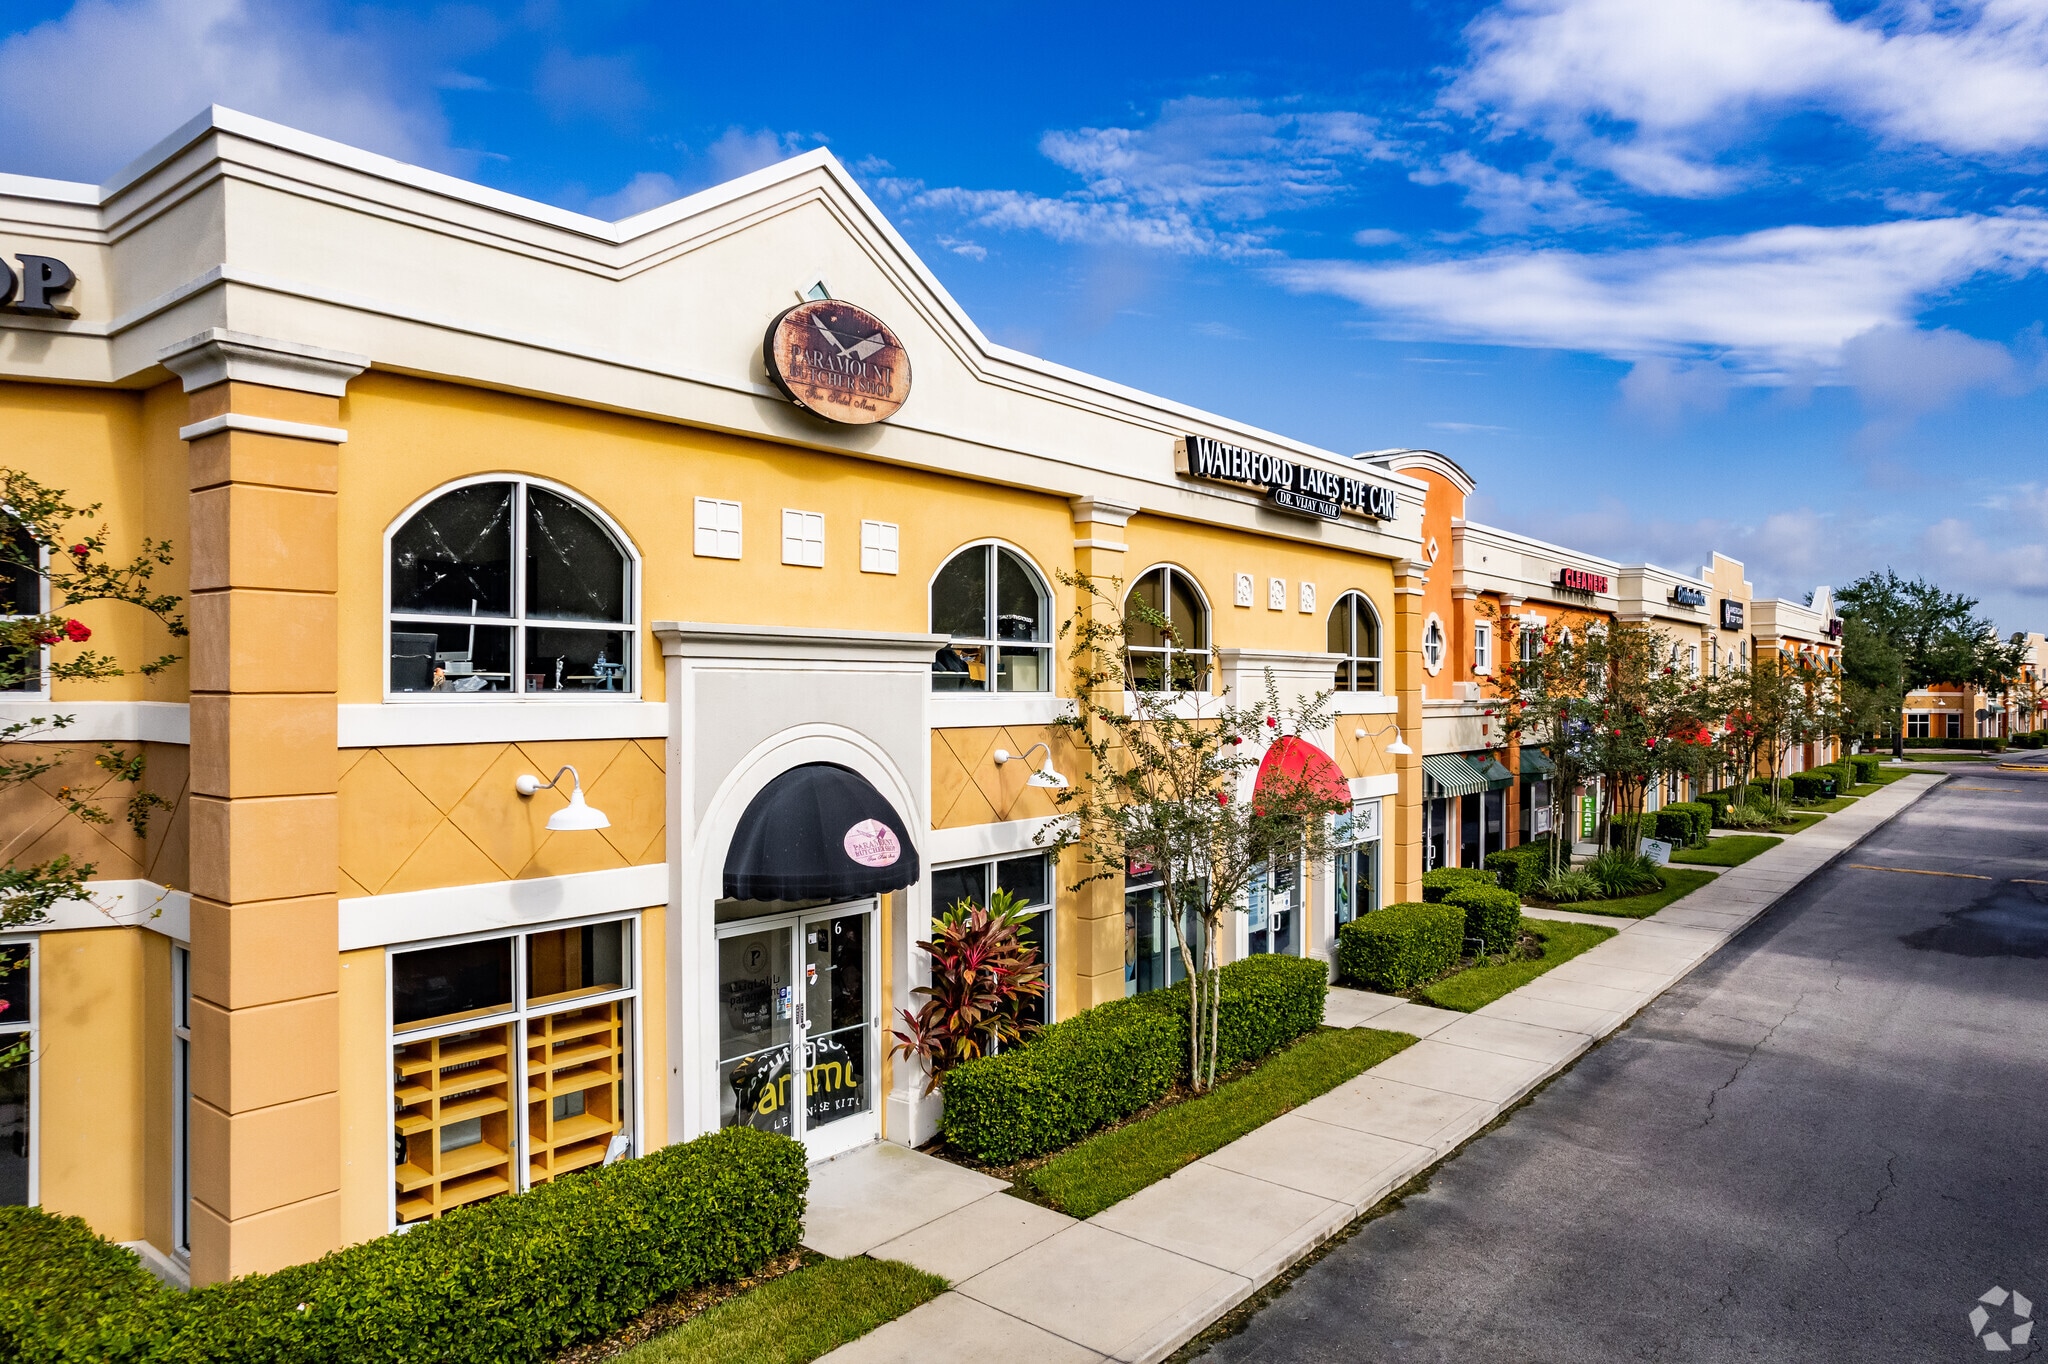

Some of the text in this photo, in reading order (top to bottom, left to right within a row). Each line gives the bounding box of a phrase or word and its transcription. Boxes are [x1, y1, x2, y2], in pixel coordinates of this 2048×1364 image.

[0, 253, 76, 310] P
[791, 344, 893, 384] PARAMOUNT
[789, 363, 893, 398] BUTCHER SHOP
[805, 386, 824, 400] Fine
[853, 398, 876, 412] Meats
[1195, 436, 1399, 520] WATERFORD LAKES EYE CARE
[1280, 491, 1337, 516] DR. VIJAY NAIR
[1565, 568, 1608, 593] CLEANERS
[834, 921, 842, 935] 6
